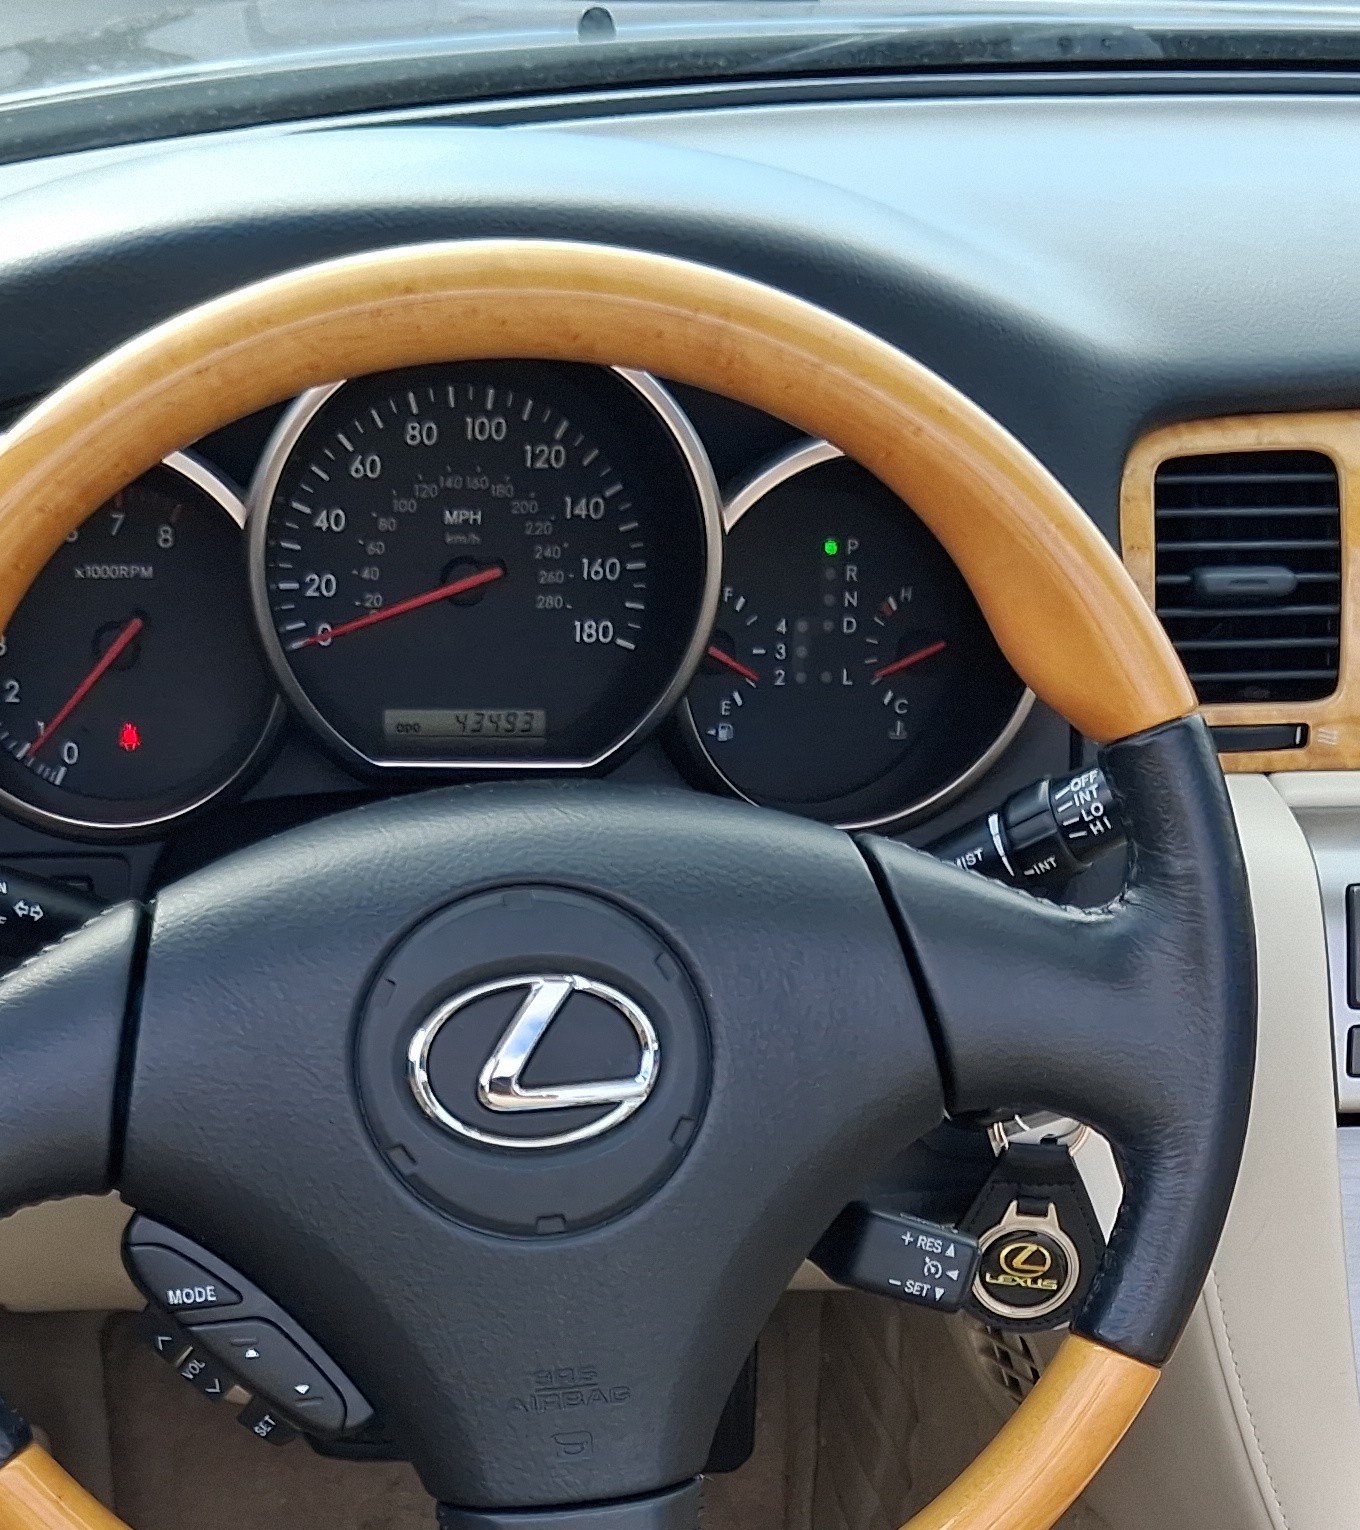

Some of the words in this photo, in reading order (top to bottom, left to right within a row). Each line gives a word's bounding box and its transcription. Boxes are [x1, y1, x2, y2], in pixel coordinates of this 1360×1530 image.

[406, 423, 438, 444] 80
[466, 418, 507, 441] 100
[525, 445, 566, 468] 120
[350, 456, 382, 479] 60
[414, 484, 438, 498] 120
[394, 500, 417, 513] 100
[565, 498, 604, 520] 140
[113, 514, 124, 536] 7
[314, 509, 346, 532] 40
[444, 510, 482, 525] MPH
[158, 526, 174, 548] 8
[848, 541, 858, 554] P
[360, 566, 379, 580] 40
[582, 558, 620, 580] 160
[846, 566, 858, 581] R
[304, 575, 336, 597] 20
[724, 588, 733, 601] F
[901, 588, 912, 600] H
[363, 593, 382, 608] 20
[845, 593, 857, 607] N
[574, 621, 613, 643] 180
[776, 620, 787, 634] 4
[843, 619, 856, 633] D
[775, 645, 786, 659] 3
[775, 671, 786, 684] 2
[843, 669, 853, 685] L
[6, 682, 20, 702] 2
[721, 702, 731, 715] E
[894, 700, 908, 714] C
[63, 743, 79, 765] 0
[1071, 769, 1098, 792] OFF
[1074, 784, 1100, 806] INT
[1081, 802, 1104, 821] LO
[1089, 816, 1112, 835] HI
[1034, 856, 1058, 874] INT
[917, 1236, 943, 1254] RES
[904, 1281, 931, 1297] SET
[985, 1273, 1058, 1290] LEXUS
[167, 1286, 216, 1304] MODE
[181, 1359, 205, 1379] VOL
[254, 1414, 276, 1437] SET
